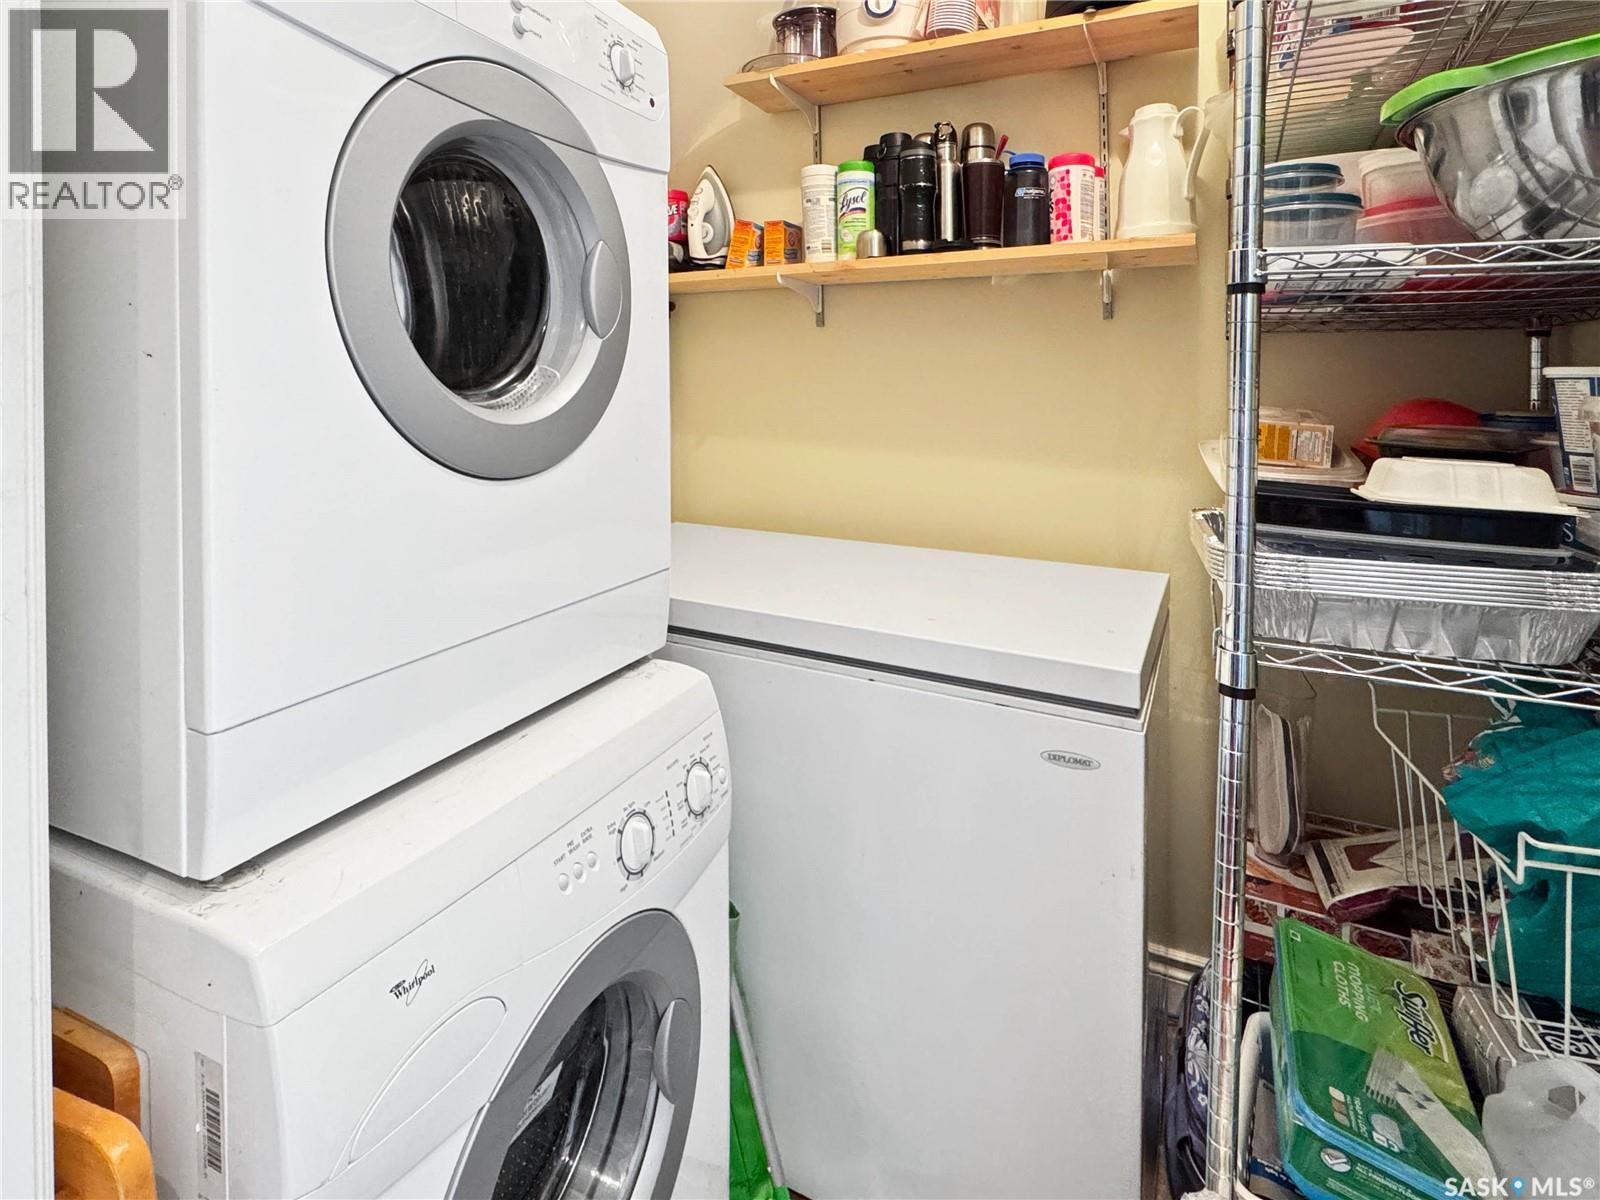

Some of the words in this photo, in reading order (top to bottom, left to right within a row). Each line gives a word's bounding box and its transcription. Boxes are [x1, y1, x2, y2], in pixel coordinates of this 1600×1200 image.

[393, 963, 436, 1000] Whirlpool
[1333, 960, 1352, 1009] CLOTHS
[1347, 961, 1369, 1023] MOPPING
[1392, 978, 1433, 1058] Swiffer
